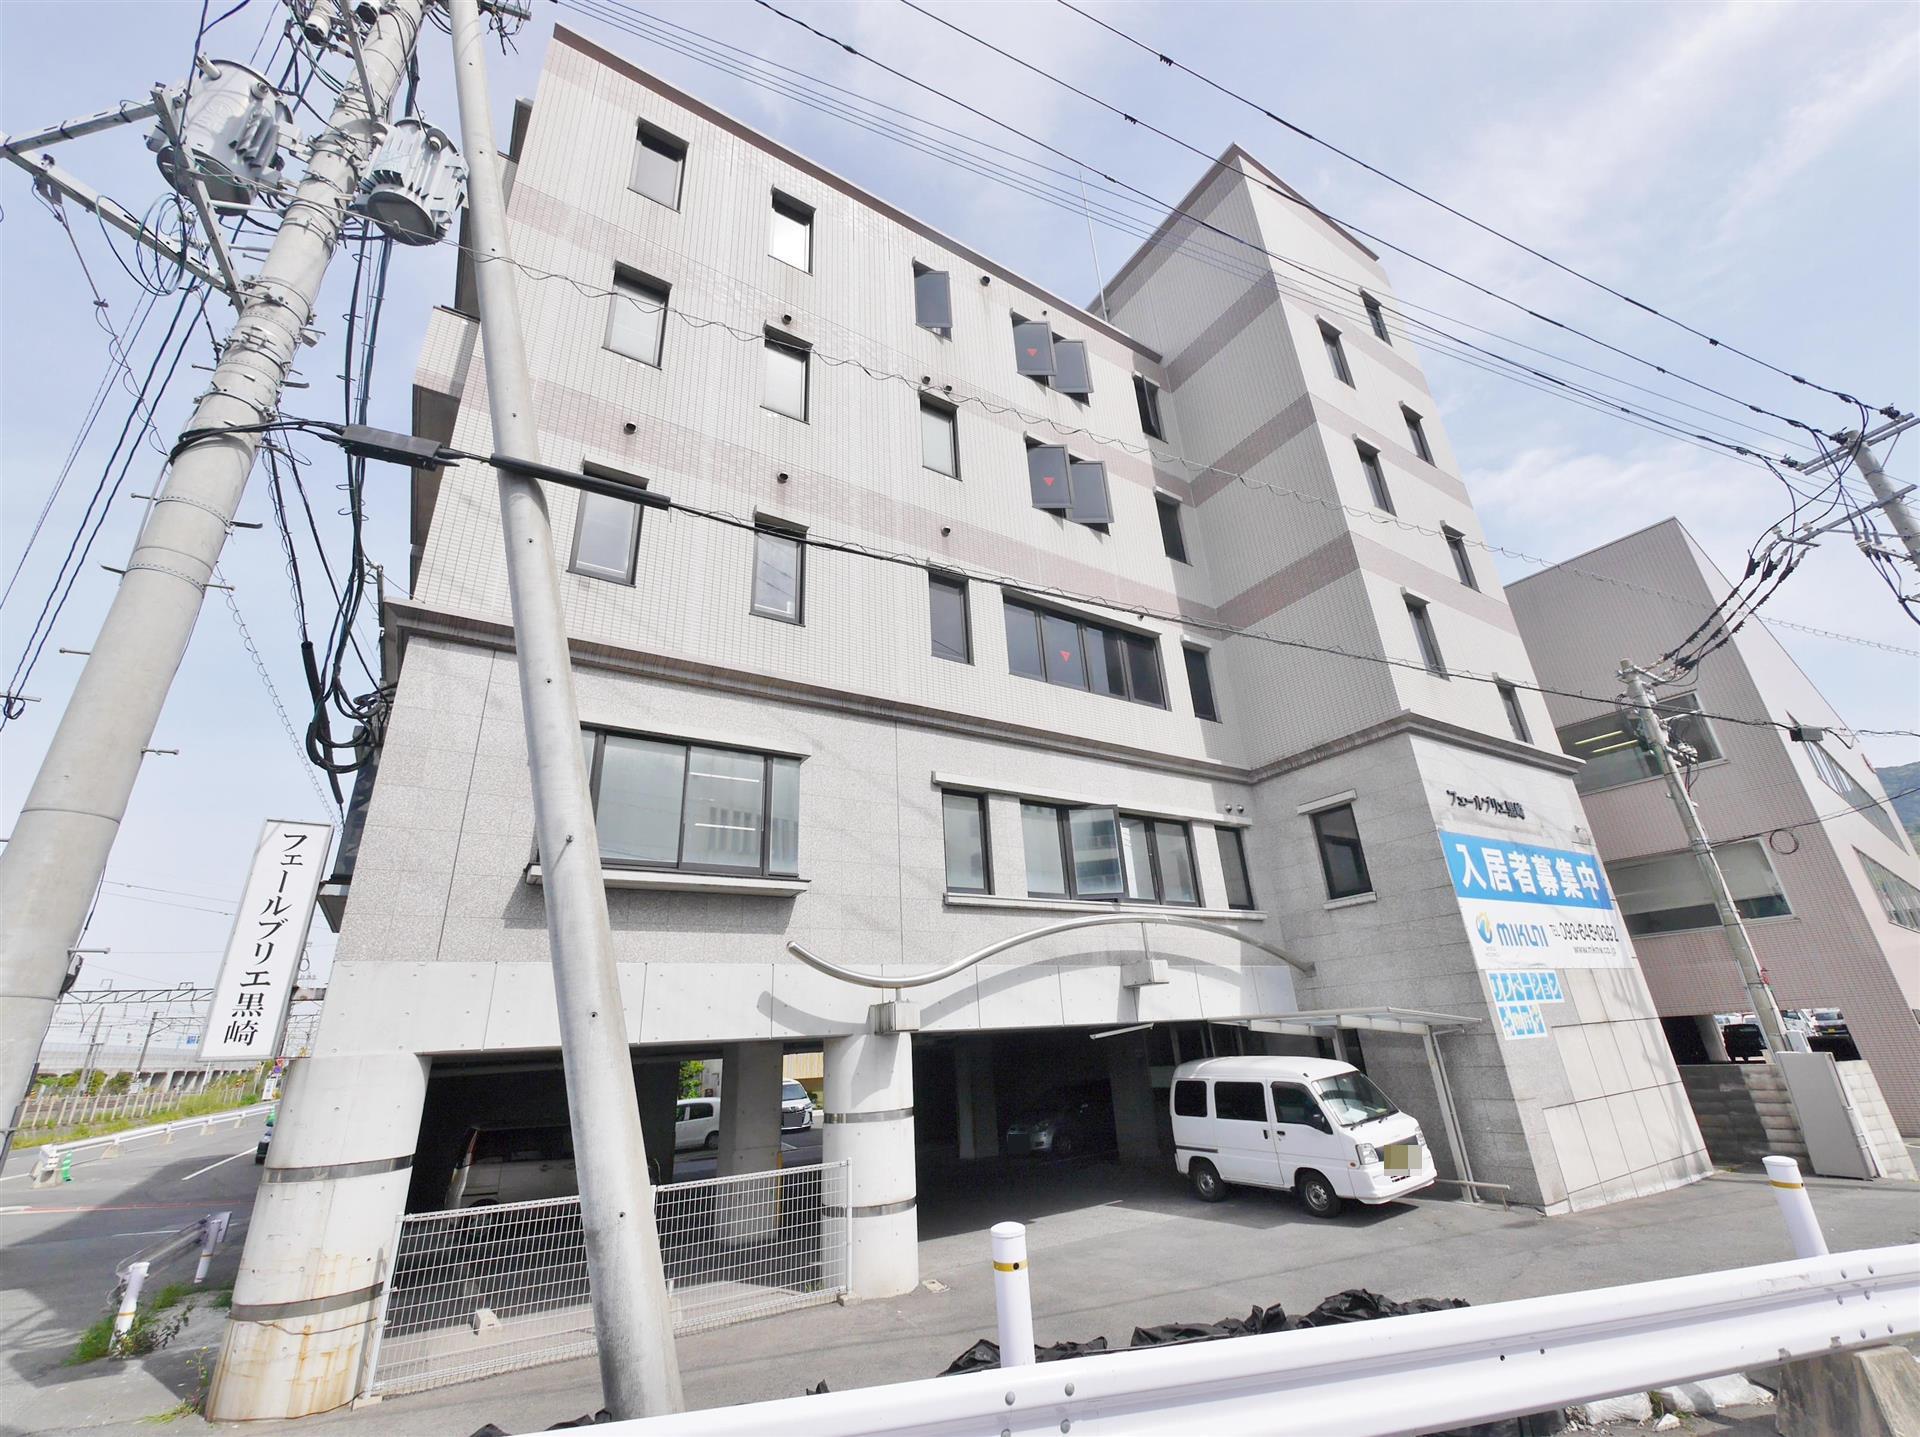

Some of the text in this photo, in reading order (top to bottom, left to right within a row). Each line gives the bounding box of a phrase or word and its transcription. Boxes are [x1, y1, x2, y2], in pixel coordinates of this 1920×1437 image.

[1455, 843, 1600, 900] 入居者募集中
[223, 833, 308, 1046] フェールブリエ黒崎
[1559, 922, 1619, 942] 093-645-0392
[1490, 973, 1560, 1000] リノベーション
